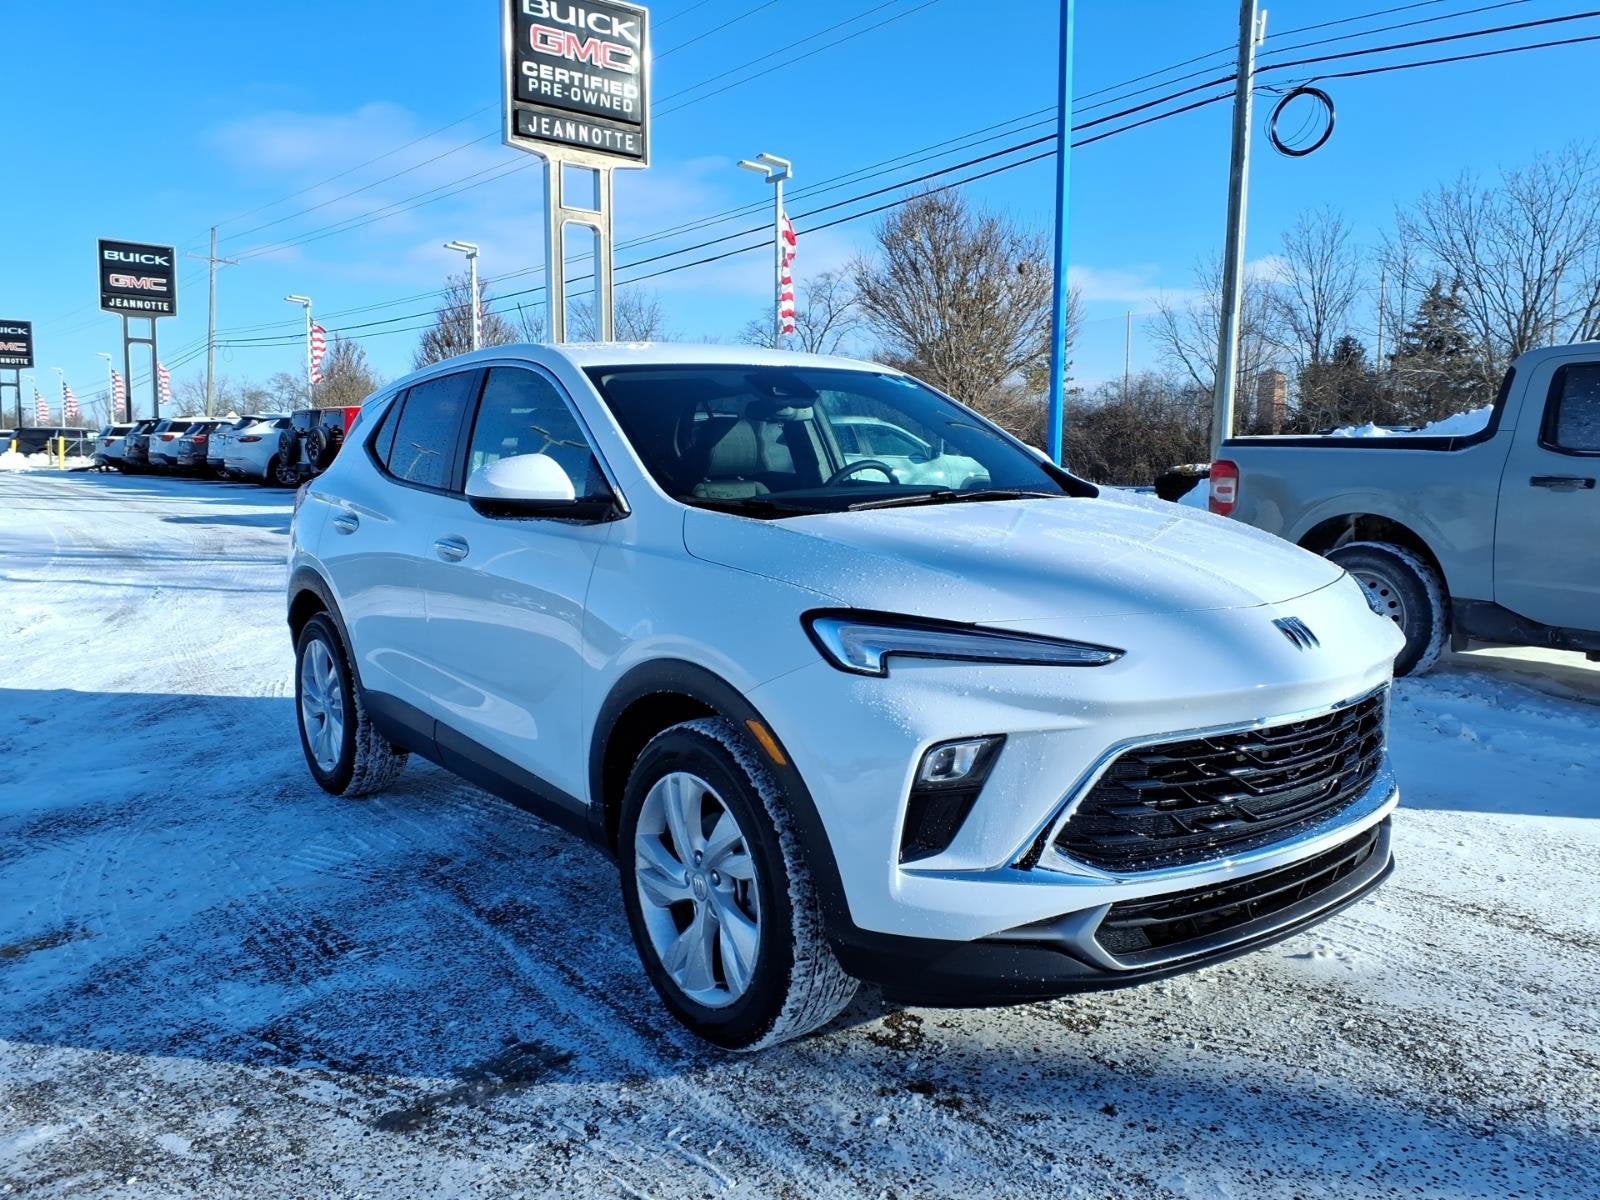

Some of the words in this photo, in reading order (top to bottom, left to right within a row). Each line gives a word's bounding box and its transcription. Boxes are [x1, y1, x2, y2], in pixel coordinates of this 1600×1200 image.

[522, 0, 640, 46] BUICK
[530, 23, 639, 74] GMC
[522, 61, 638, 99] CERTIFIED
[528, 78, 633, 112] PRE-OWNED
[528, 116, 635, 151] JEANNOTTE
[104, 250, 170, 266] BUICK
[109, 273, 167, 291] GMC
[109, 298, 169, 311] JEANNOTTE
[0, 326, 28, 335] ICK
[0, 341, 27, 352] MC
